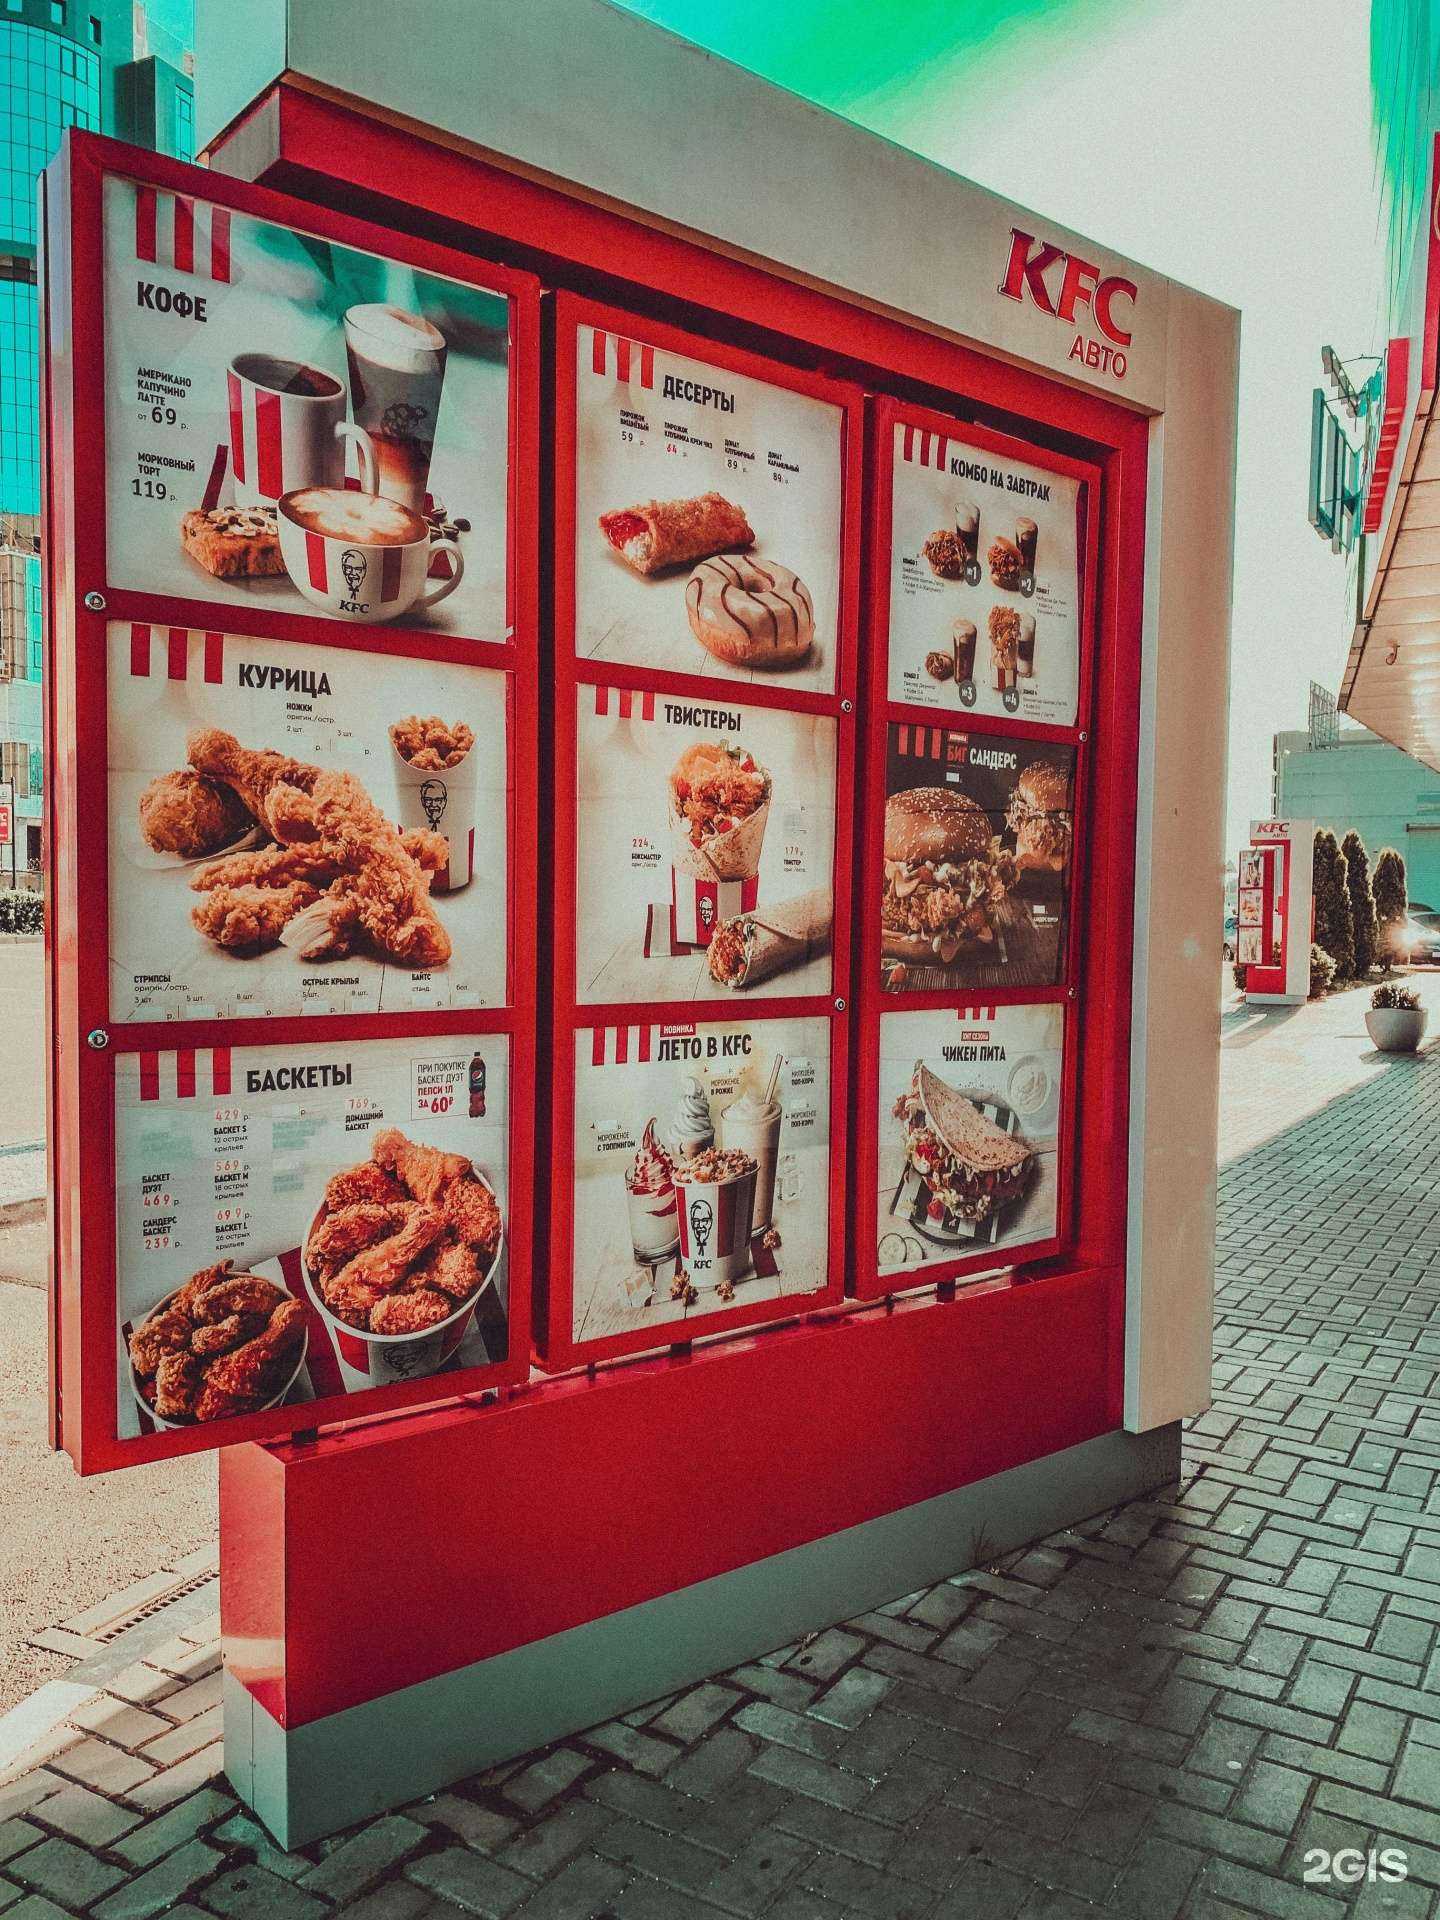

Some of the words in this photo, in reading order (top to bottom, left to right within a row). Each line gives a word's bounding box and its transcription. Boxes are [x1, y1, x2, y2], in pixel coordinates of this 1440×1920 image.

[998, 227, 1138, 348] KFC
[138, 281, 207, 323] КОФЕ
[1067, 334, 1127, 379] АВТО
[138, 367, 192, 388] АМЕРИКАНО
[138, 380, 187, 399] КАПУЧИНО
[663, 374, 735, 414] ДЕСЕРТЫ
[138, 392, 166, 406] ЛАТТЕ
[152, 407, 176, 425] 69
[622, 431, 634, 442] 59
[138, 452, 195, 472] МОРКОВНЫЙ
[727, 459, 738, 470] 89
[138, 464, 161, 476] ТОРТ
[773, 473, 782, 483] 89
[951, 457, 988, 485] КОМБО
[989, 473, 1005, 490] НА
[1007, 475, 1051, 502] ЗАВТРАК
[132, 479, 167, 500] 119
[339, 600, 370, 614] KFC
[239, 663, 332, 699] КУРИЦА
[287, 702, 312, 712] НОЖКИ
[665, 704, 742, 732] ТВИСТЕРЫ
[970, 748, 1017, 770] САНДЕРС
[1256, 823, 1290, 833] KFC
[134, 975, 171, 984] СТРИПСЫ
[303, 978, 330, 986] ОСТРЫЕ
[331, 977, 360, 986] КРЫЛЬЯ
[411, 973, 432, 981] БАЙТС
[663, 1025, 695, 1035] НОВИНКА
[657, 1037, 702, 1062] ЛЕТО
[707, 1037, 718, 1058] В
[722, 1034, 752, 1057] KFC
[942, 1046, 978, 1062] ЧИКЕН
[980, 1046, 1006, 1062] ПИТА
[417, 1064, 433, 1074] ПРИ
[434, 1061, 467, 1073] ПОКУПКЕ
[247, 1063, 352, 1093] БАСКЕТЫ
[417, 1074, 445, 1086] БАСКЕТ
[446, 1072, 464, 1083] ДУЭТ
[417, 1086, 443, 1096] ПЕПСИ
[445, 1085, 454, 1094] 1Л
[418, 1099, 430, 1109] ЗА
[345, 1109, 384, 1123] ДОМАШНИЙ
[214, 1126, 240, 1135] БАСКЕТ
[345, 1122, 370, 1132] БАСКЕТ
[216, 1160, 238, 1171] 569
[142, 1174, 170, 1183] БАСКЕТ
[215, 1174, 241, 1183] БАСКЕТ
[142, 1184, 162, 1194] ДУЭТ
[223, 1183, 248, 1191] острых
[144, 1195, 170, 1206] 469
[143, 1216, 178, 1228] САНДЕРС
[216, 1223, 242, 1233] БАСКЕТ
[143, 1226, 171, 1236] БАСКЕТ
[145, 1237, 169, 1250] 239
[694, 1259, 712, 1270] KFC
